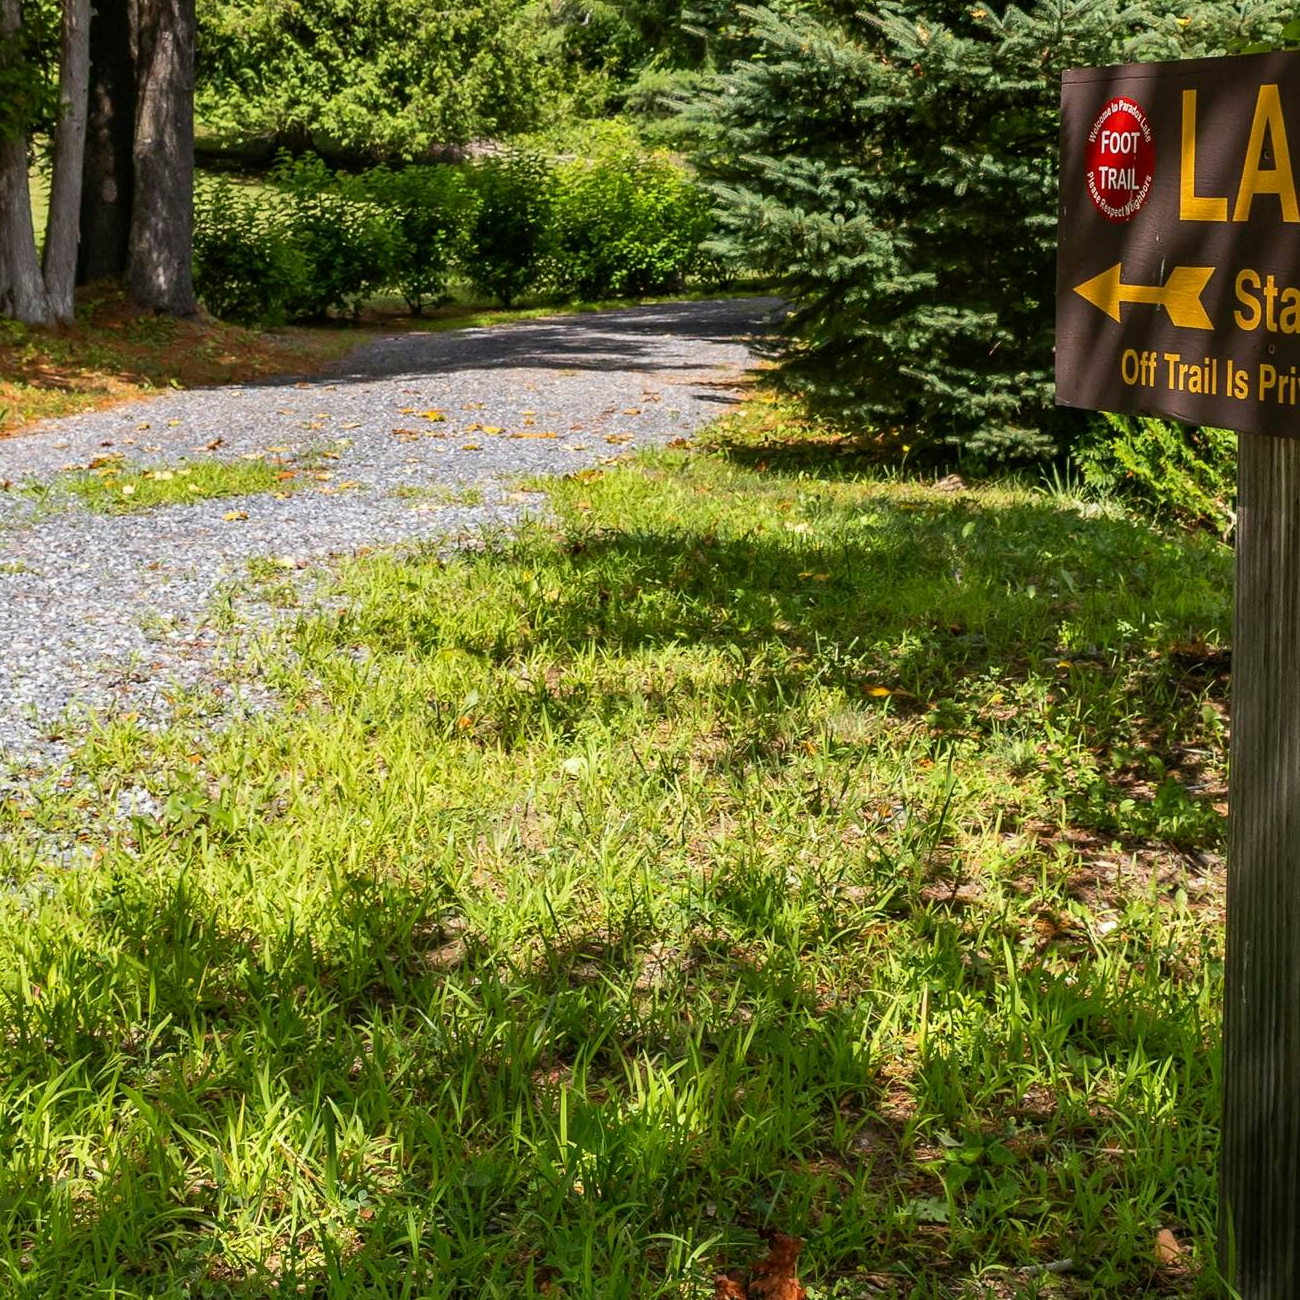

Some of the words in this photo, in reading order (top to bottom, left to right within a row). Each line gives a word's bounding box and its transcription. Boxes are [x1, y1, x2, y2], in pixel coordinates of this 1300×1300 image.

[1089, 108, 1111, 143] Welcome
[1111, 103, 1118, 113] to
[1119, 100, 1142, 122] Paradox
[1140, 117, 1152, 143] Lake
[1101, 131, 1140, 154] FOOT
[1087, 172, 1101, 203] Please
[1100, 199, 1124, 218] Respect
[1125, 175, 1152, 216] Neighbors
[1099, 166, 1140, 190] TRAIL
[1122, 349, 1158, 387] Off
[1164, 353, 1217, 395] Trail
[1226, 360, 1250, 399] Is
